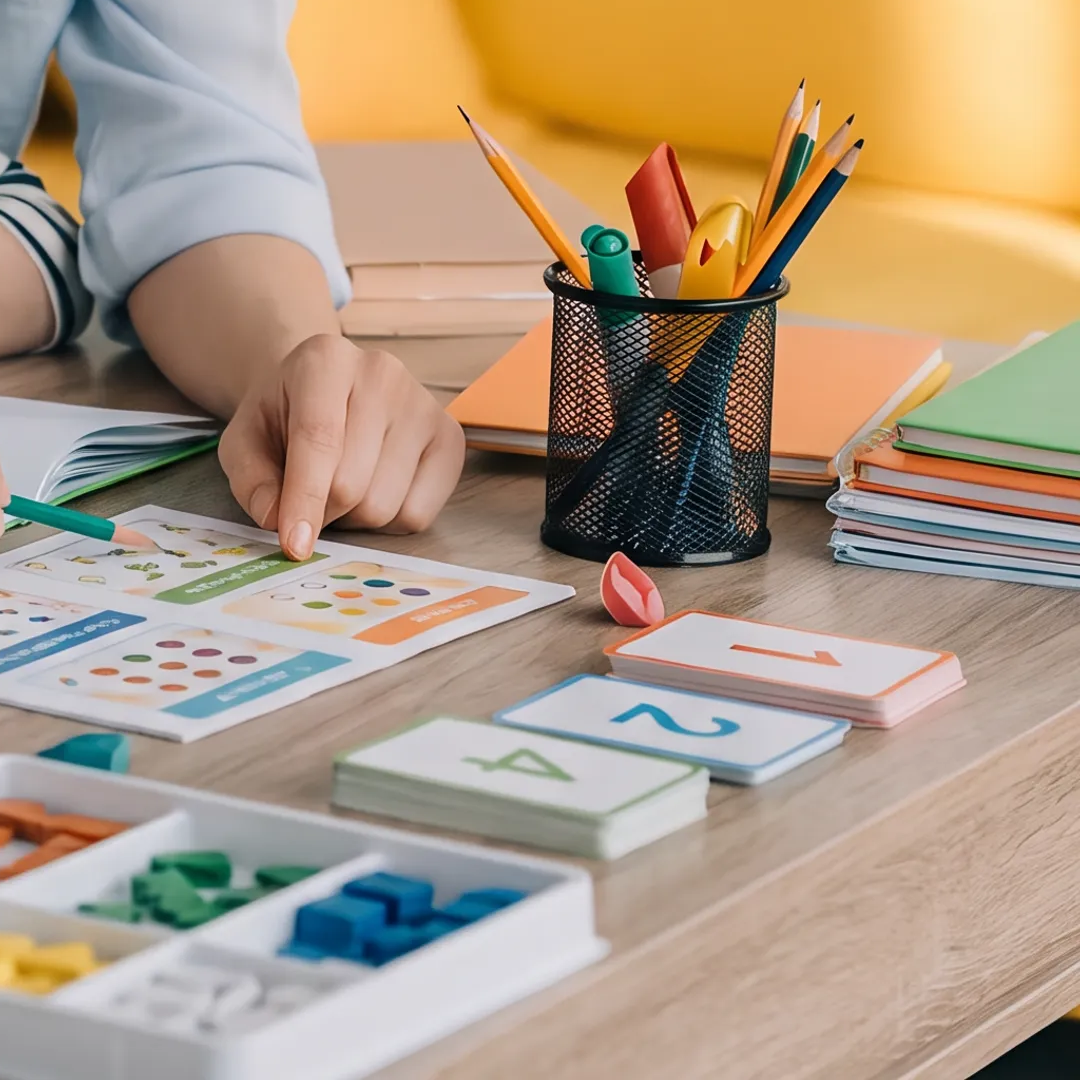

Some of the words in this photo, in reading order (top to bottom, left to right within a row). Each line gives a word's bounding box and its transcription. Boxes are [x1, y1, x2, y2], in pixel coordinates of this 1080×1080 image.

[729, 644, 842, 667] 1
[609, 702, 741, 738] 2
[460, 748, 577, 782] 4
